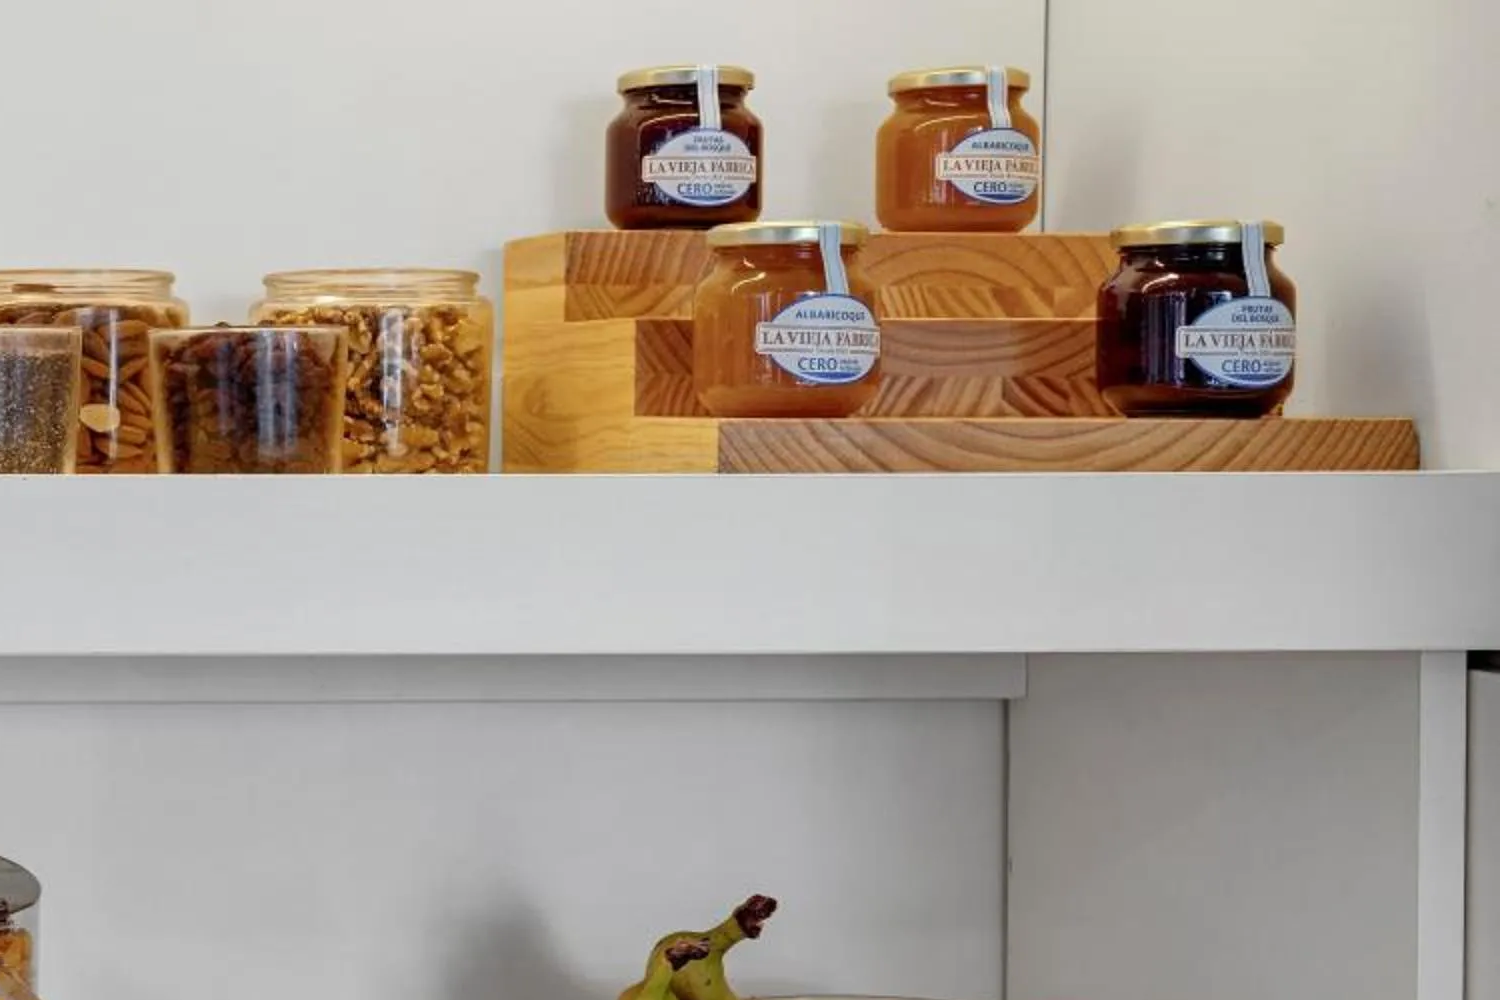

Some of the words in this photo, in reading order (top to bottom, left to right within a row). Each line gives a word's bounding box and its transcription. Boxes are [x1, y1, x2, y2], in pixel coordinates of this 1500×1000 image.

[649, 161, 666, 174] LA
[669, 161, 706, 175] VIEJA
[943, 159, 962, 172] LA
[964, 159, 1002, 173] VIEJA
[677, 183, 713, 195] CERO
[973, 181, 1007, 193] CERO
[762, 331, 784, 345] LA
[787, 331, 831, 347] VIEJA
[1184, 334, 1207, 348] LA
[1209, 333, 1255, 350] VIEJA
[797, 357, 837, 371] CERO
[1221, 359, 1262, 373] CERO
